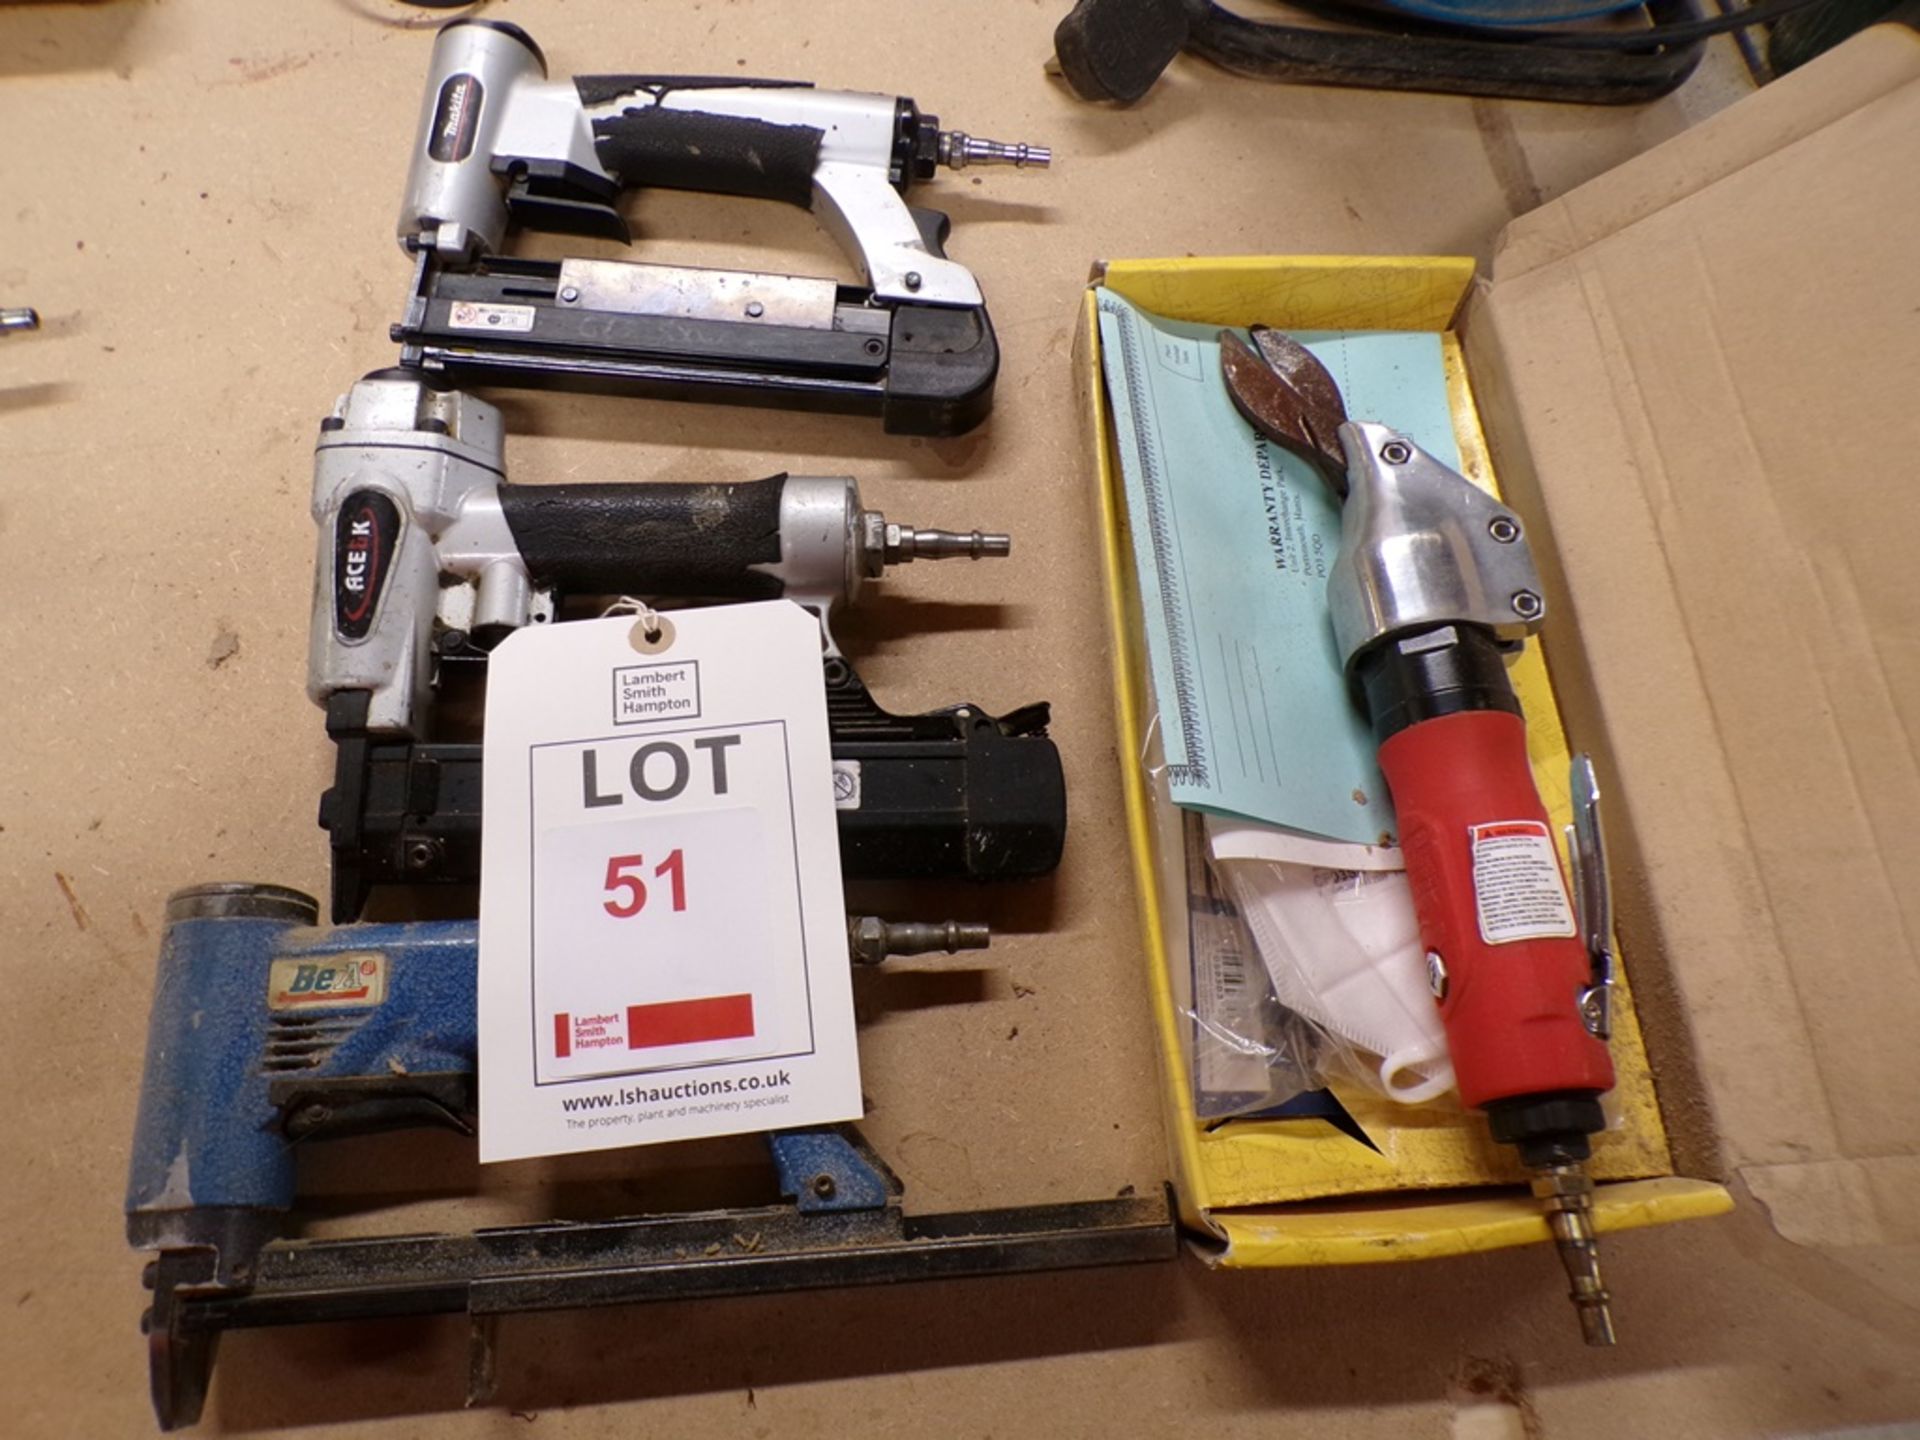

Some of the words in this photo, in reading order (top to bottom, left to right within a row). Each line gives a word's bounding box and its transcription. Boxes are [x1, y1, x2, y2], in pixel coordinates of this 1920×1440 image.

[1254, 431, 1273, 481] DEPAR
[1261, 482, 1287, 570] WARRANTY
[622, 670, 686, 686] Lambert
[622, 685, 667, 700] Smith
[623, 699, 691, 714] Hampton
[582, 734, 741, 809] LOT
[603, 848, 687, 919] 51
[575, 1013, 619, 1026] Lambert
[575, 1025, 606, 1037] Smith
[575, 1036, 624, 1049] Hampton
[562, 1069, 792, 1112] www.lshauctions.co.uk
[566, 1118, 586, 1129] The
[588, 1112, 635, 1129] property,
[637, 1107, 664, 1123] plant
[666, 1105, 687, 1117] and
[688, 1098, 742, 1115] machinery
[743, 1093, 791, 1110] specialist
